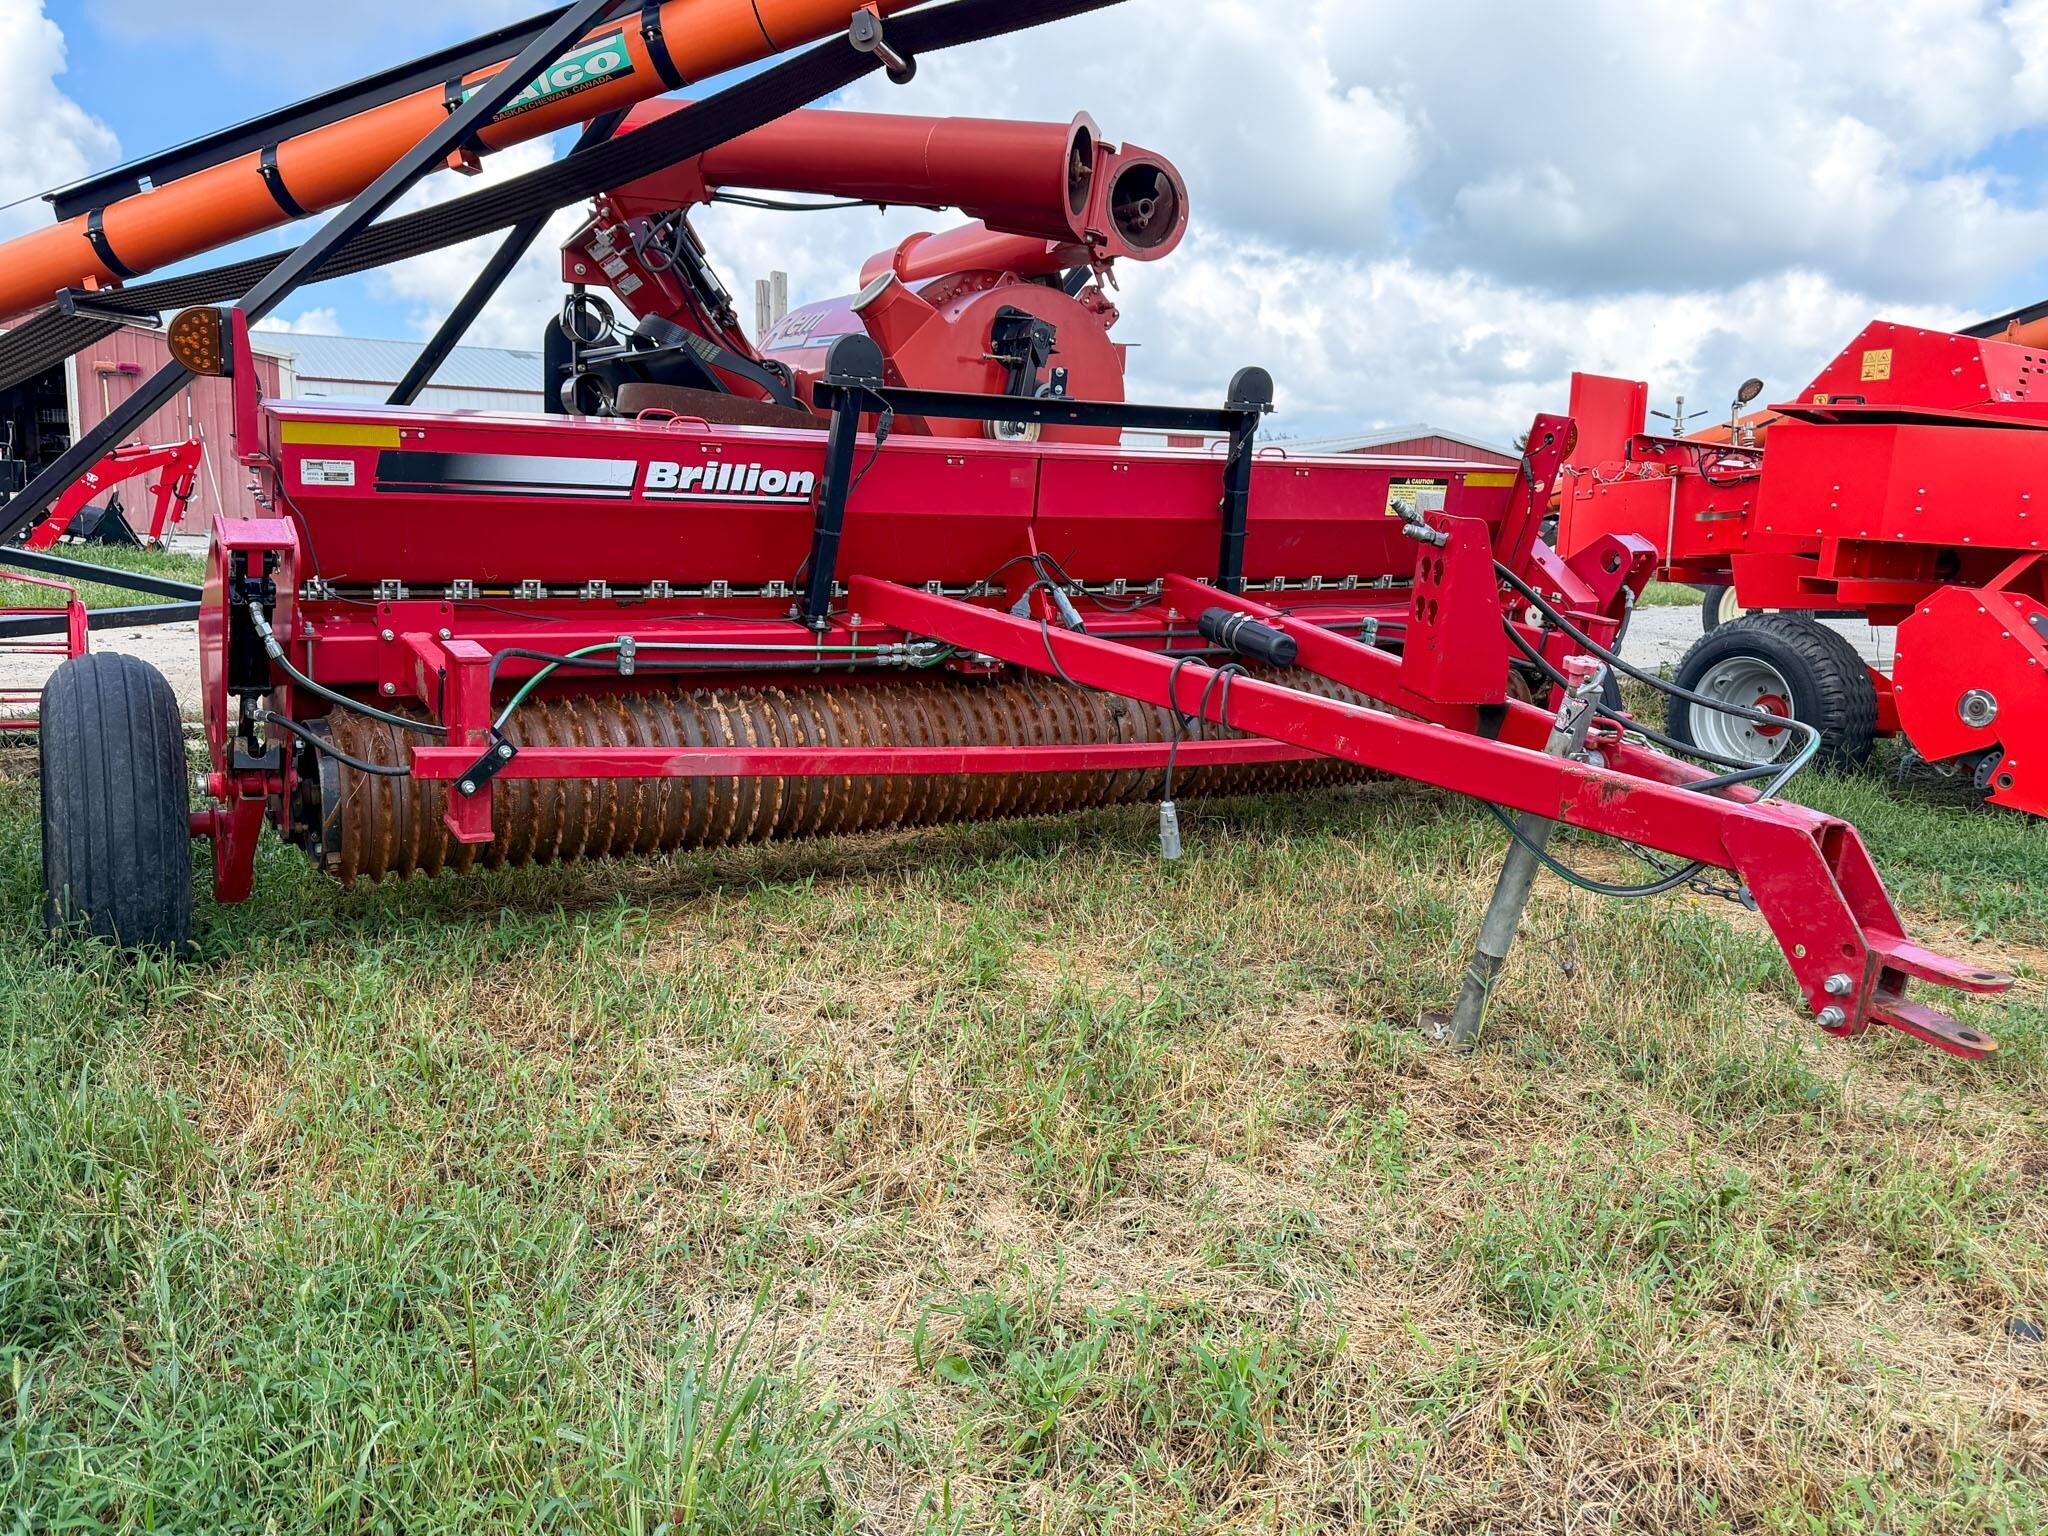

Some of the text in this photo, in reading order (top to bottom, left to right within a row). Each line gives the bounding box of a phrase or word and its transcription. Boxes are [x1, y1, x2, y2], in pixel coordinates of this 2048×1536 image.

[468, 42, 622, 107] ATCO
[492, 74, 614, 123] SASKATCHEWAN, CANADA
[644, 461, 815, 493] Brillion
